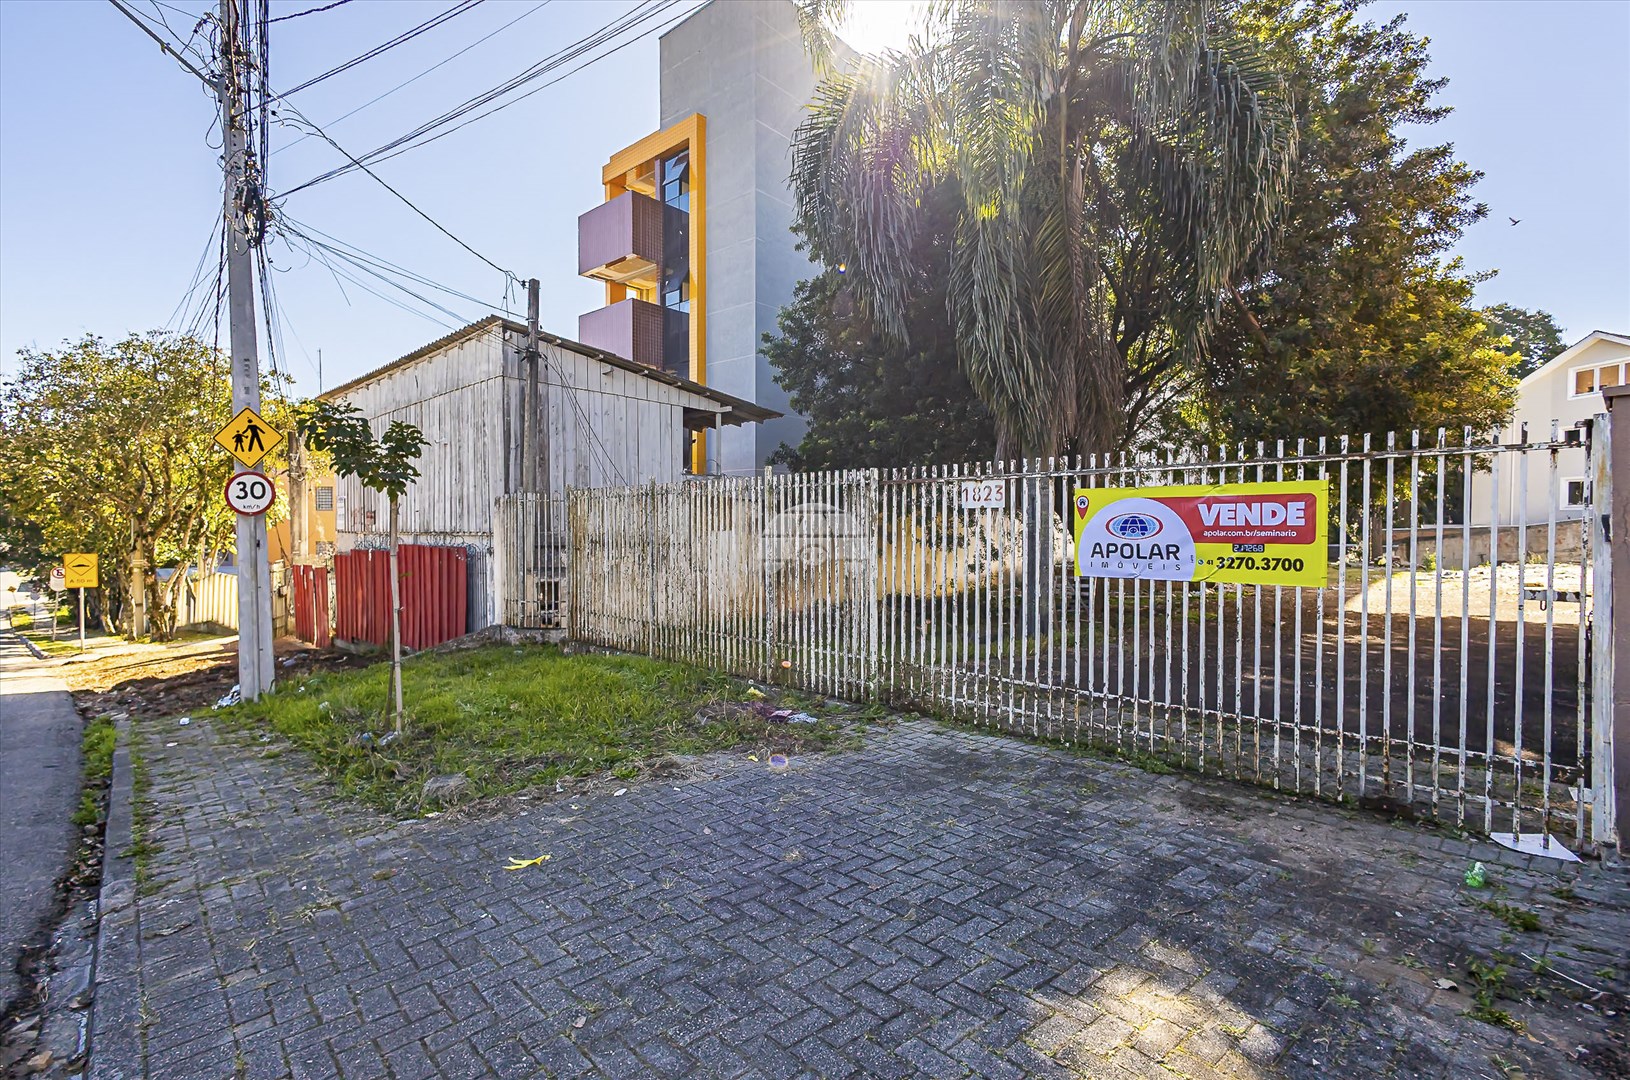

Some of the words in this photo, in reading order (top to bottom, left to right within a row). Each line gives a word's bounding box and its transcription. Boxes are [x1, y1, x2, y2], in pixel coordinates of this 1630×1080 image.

[235, 481, 266, 500] 30
[962, 485, 1004, 502] 1823
[1197, 501, 1306, 526] VENDE
[1203, 529, 1297, 538] apolar.com.br/seminario
[1090, 542, 1180, 560] APOLAR
[1090, 561, 1181, 571] IMÓVEIS
[1216, 556, 1304, 572] 3270.3700
